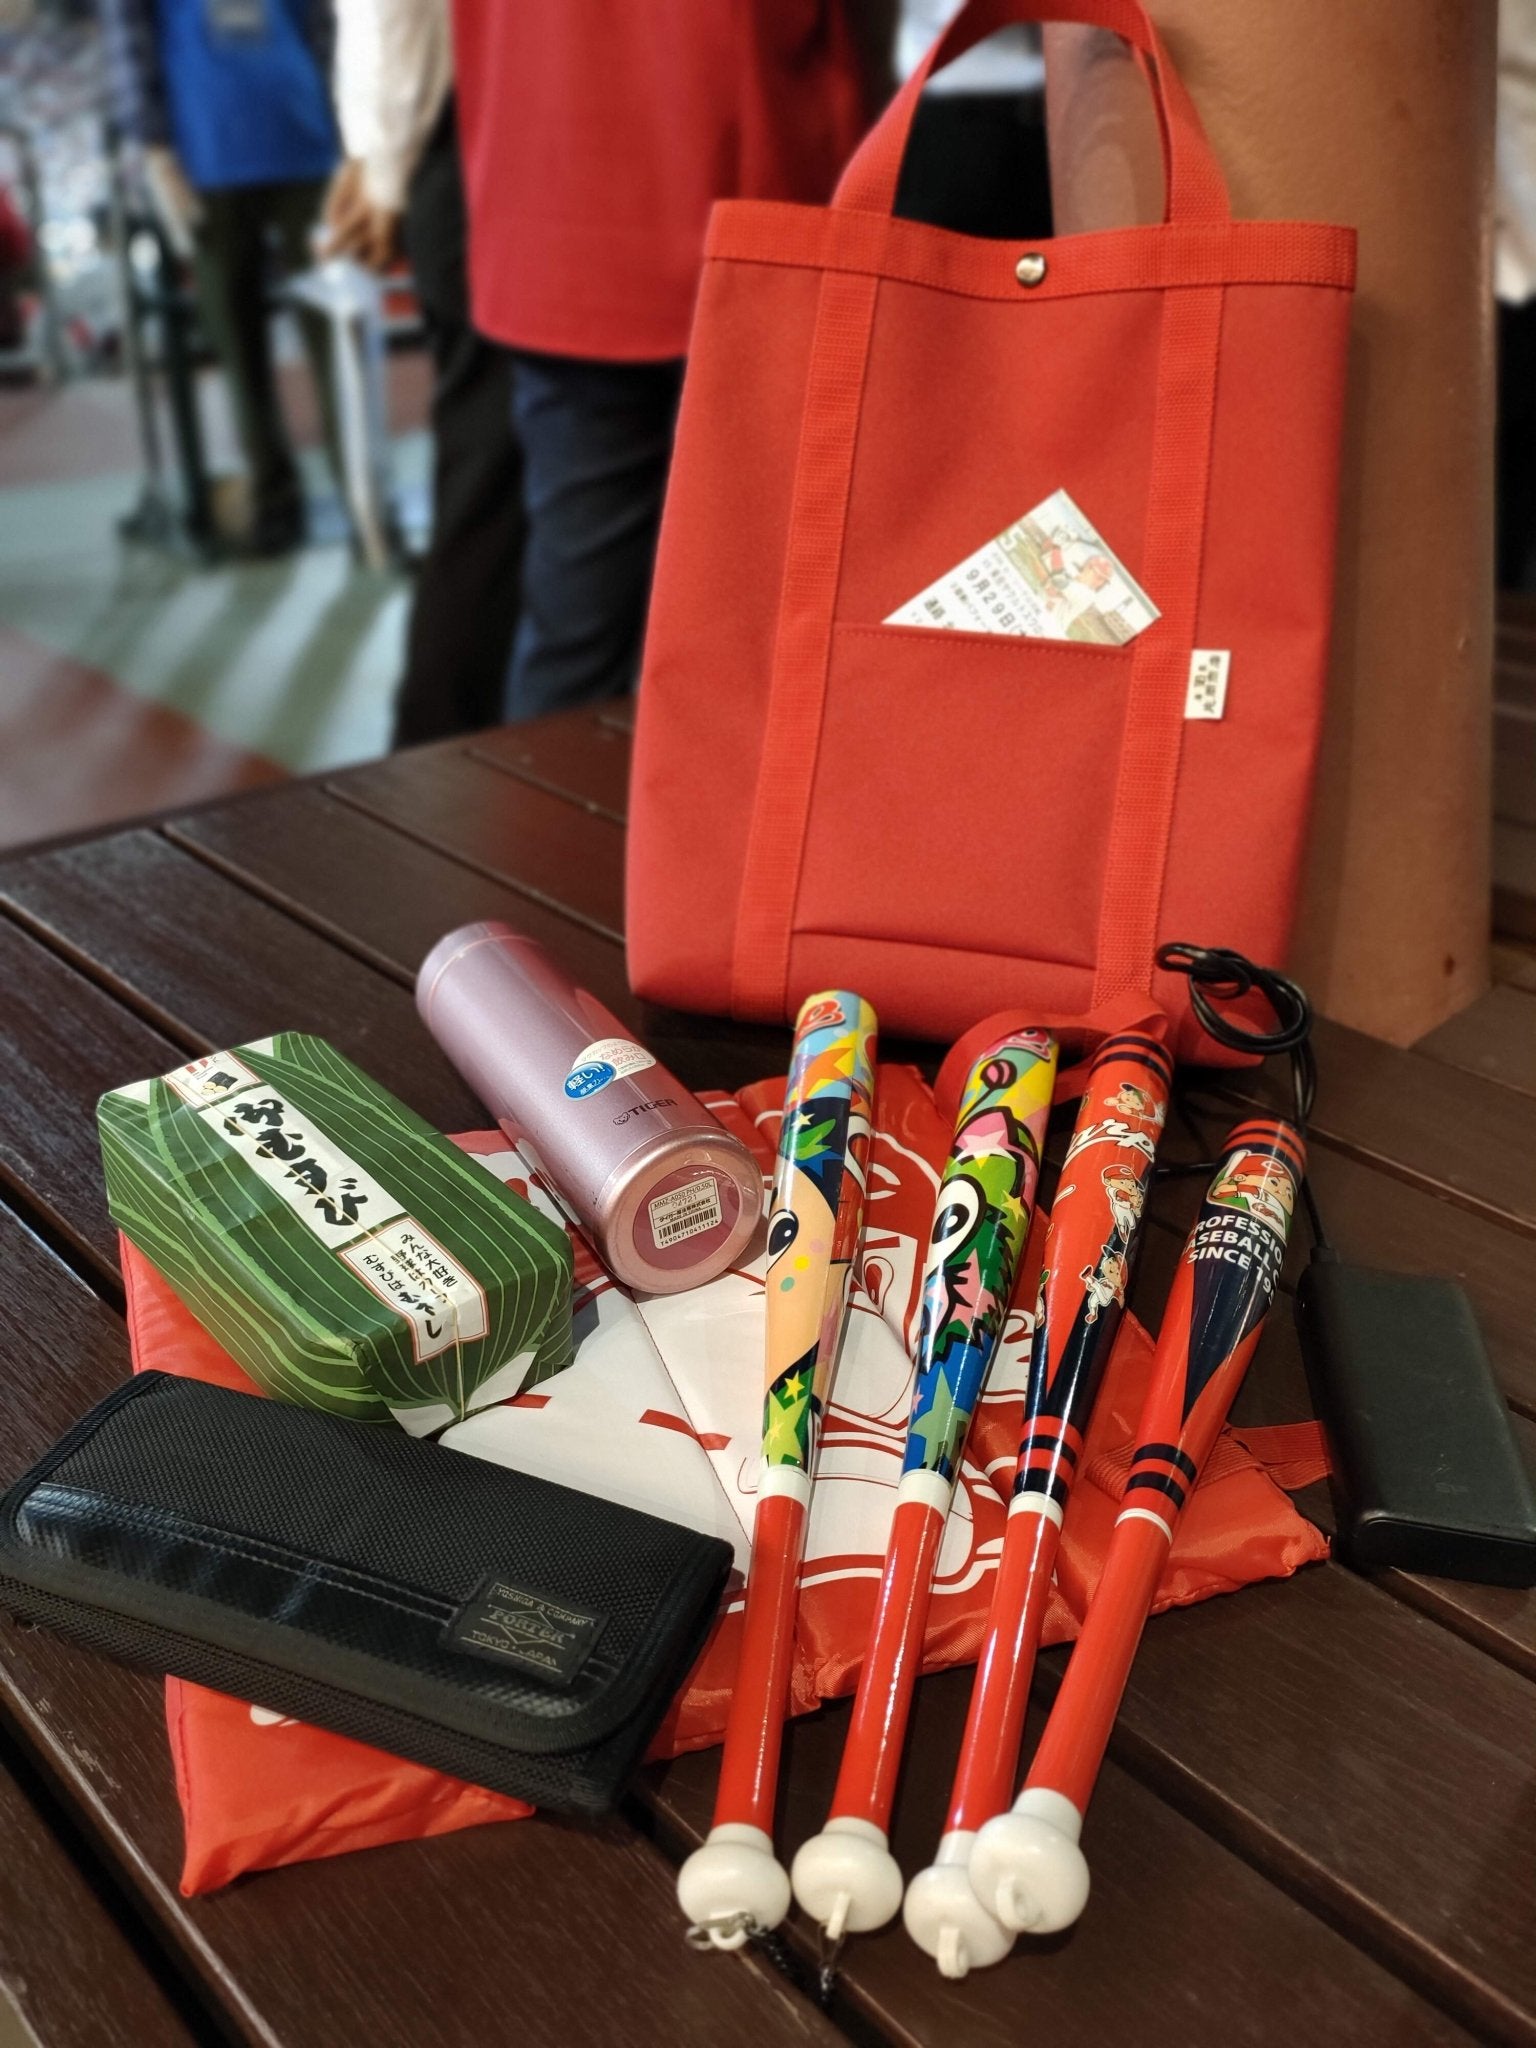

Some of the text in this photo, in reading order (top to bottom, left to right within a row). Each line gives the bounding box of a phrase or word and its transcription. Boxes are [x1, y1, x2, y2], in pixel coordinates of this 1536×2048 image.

[628, 1099, 678, 1116] TIGER
[661, 1219, 719, 1246] T4904710411124
[1192, 1215, 1282, 1266] ROFESSIO
[400, 1233, 458, 1288] みんな大好き
[1186, 1230, 1270, 1271] ASEBALL
[1187, 1247, 1251, 1271] SINCE
[489, 1609, 566, 1644] PORTER
[547, 1607, 589, 1626] COMPANY
[472, 1630, 510, 1649] TOKYO
